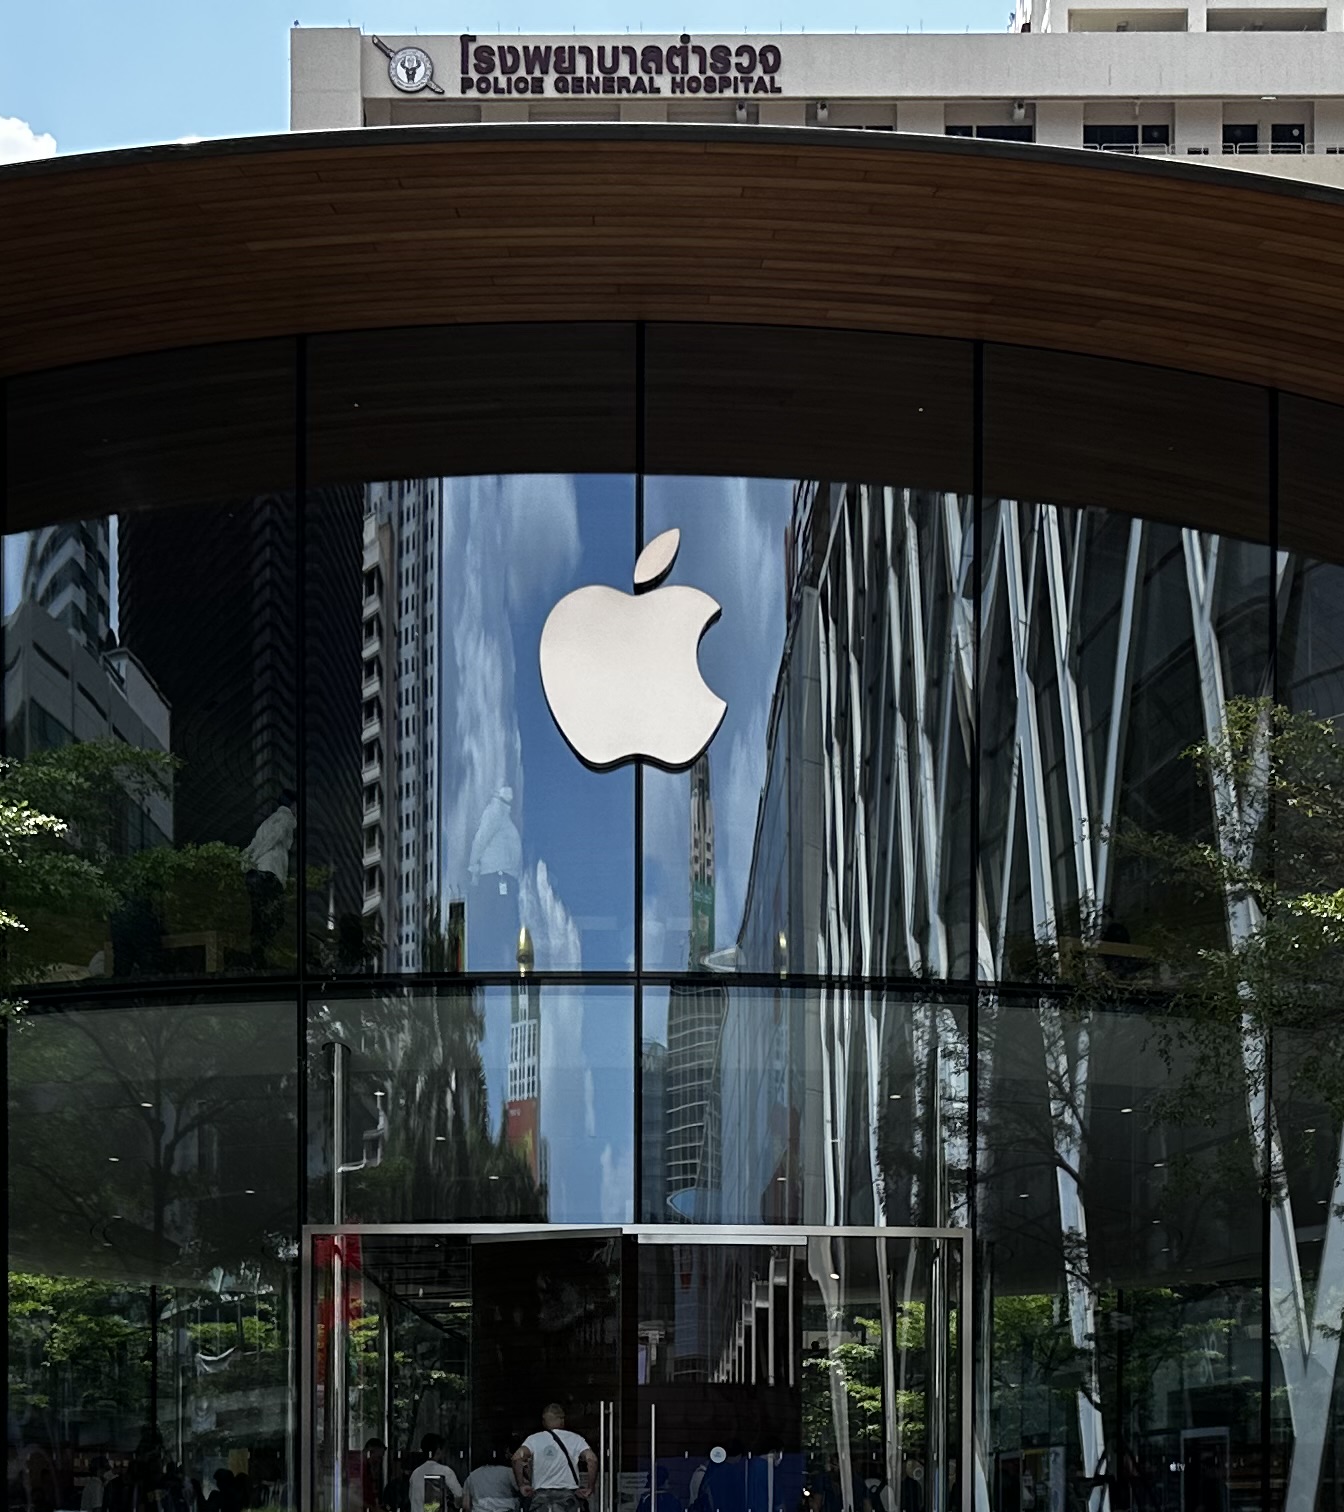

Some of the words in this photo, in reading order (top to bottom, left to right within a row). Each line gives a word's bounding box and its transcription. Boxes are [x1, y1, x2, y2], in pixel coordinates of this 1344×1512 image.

[460, 34, 782, 75] โรงพยาบาลตำรวจ
[460, 76, 545, 95] POLICE
[554, 76, 662, 95] GENERAL
[671, 76, 782, 95] HOSPITAL
